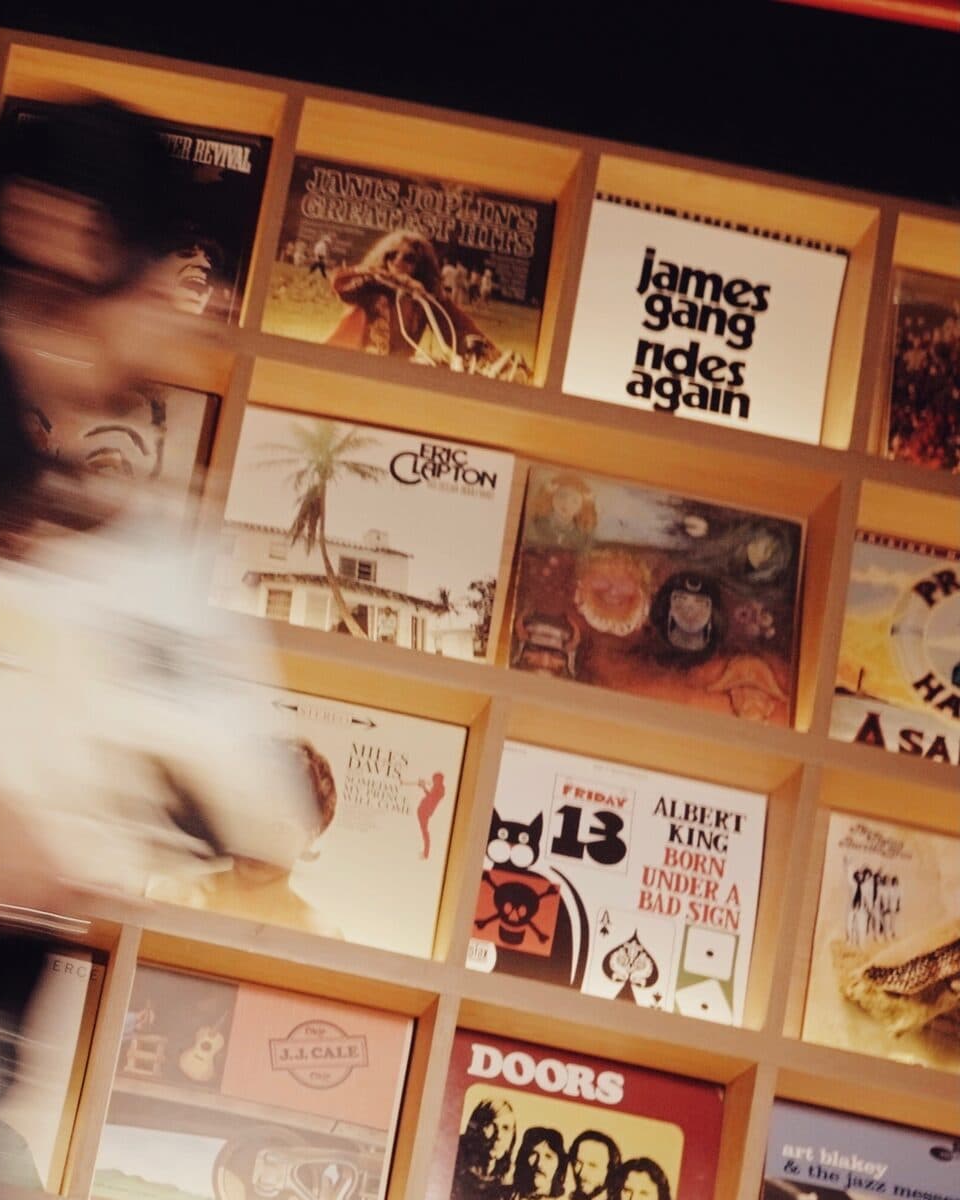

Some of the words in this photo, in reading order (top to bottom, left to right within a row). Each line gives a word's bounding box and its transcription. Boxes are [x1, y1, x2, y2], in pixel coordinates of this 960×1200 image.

[193, 138, 251, 174] REVIVAL
[302, 193, 453, 244] GREATEST
[306, 167, 401, 203] JANIS
[401, 183, 538, 234] JOPLIN'S
[637, 246, 771, 313] james
[642, 292, 757, 351] gang
[635, 338, 746, 387] rides
[625, 369, 751, 420] again
[389, 452, 497, 489] CLAPTON
[420, 443, 468, 465] ERIC
[348, 755, 402, 778] DAVIS
[351, 743, 409, 767] MILES
[562, 784, 628, 809] FRIDAY
[652, 796, 747, 832] ALBERT
[551, 804, 627, 865] 13
[668, 823, 729, 853] KING
[664, 847, 726, 879] BORN
[642, 866, 718, 896] UNDER
[726, 883, 741, 906] A
[638, 891, 682, 918] BAD
[685, 900, 741, 931] SIGN
[311, 1045, 360, 1060] CALE
[467, 1043, 625, 1105] DOORS
[782, 1143, 814, 1162] art
[820, 1147, 889, 1181] blakey
[783, 1160, 801, 1175] &
[808, 1164, 840, 1184] the
[846, 1171, 887, 1193] jazz
